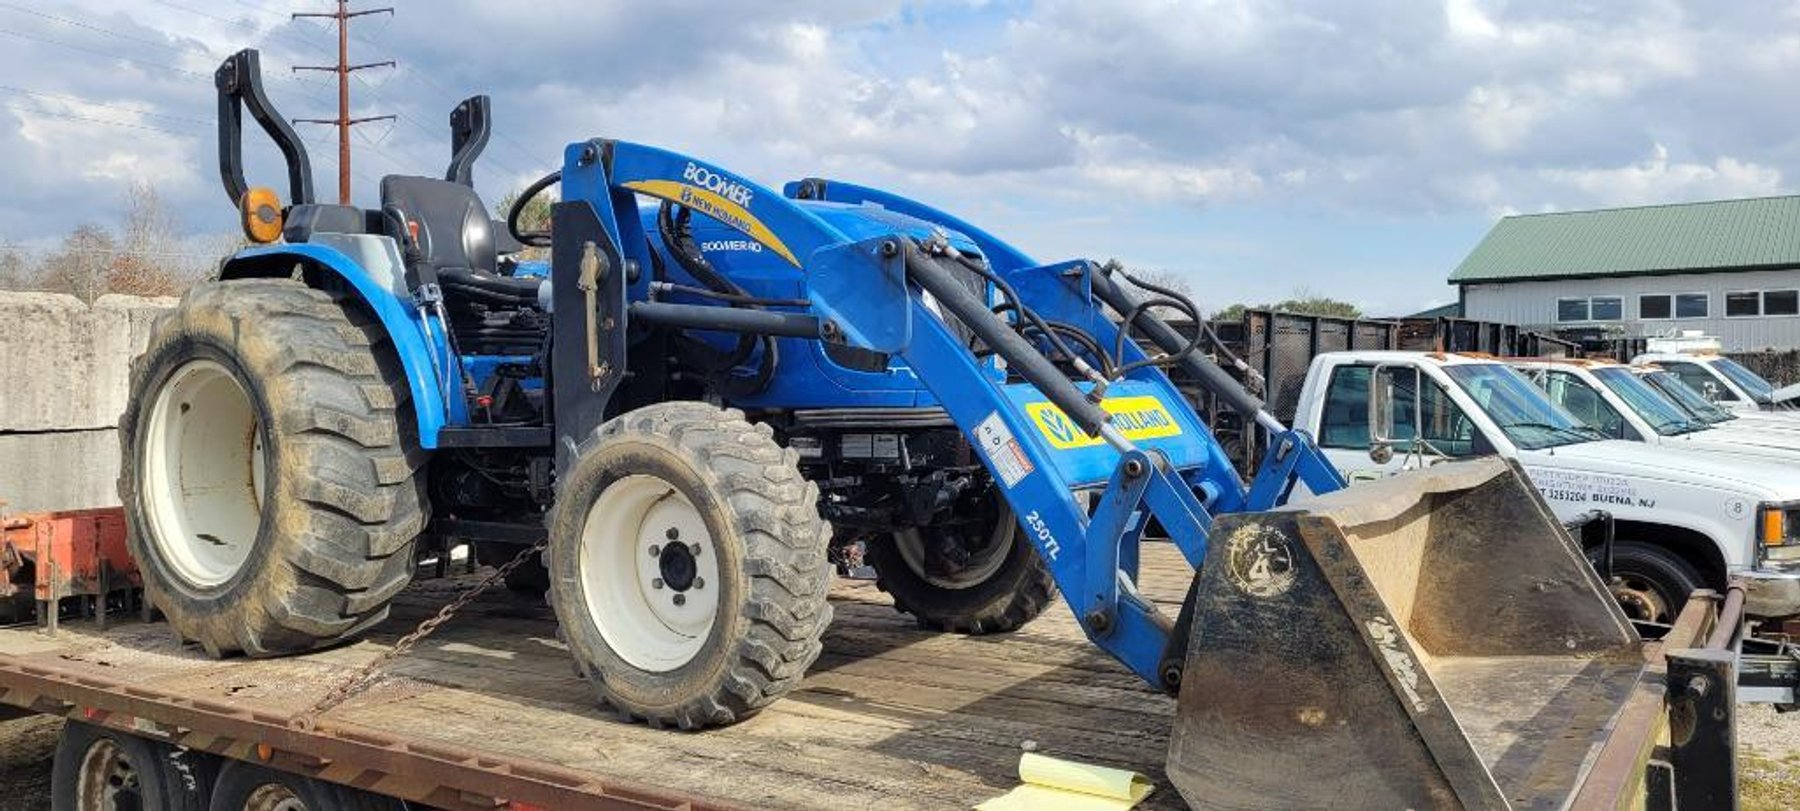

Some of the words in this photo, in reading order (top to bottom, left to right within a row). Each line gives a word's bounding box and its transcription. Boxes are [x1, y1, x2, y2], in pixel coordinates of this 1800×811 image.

[683, 162, 752, 207] BOOMER
[694, 195, 711, 212] NEW
[1639, 498, 1656, 508] NJ
[1025, 510, 1062, 561] 250TL
